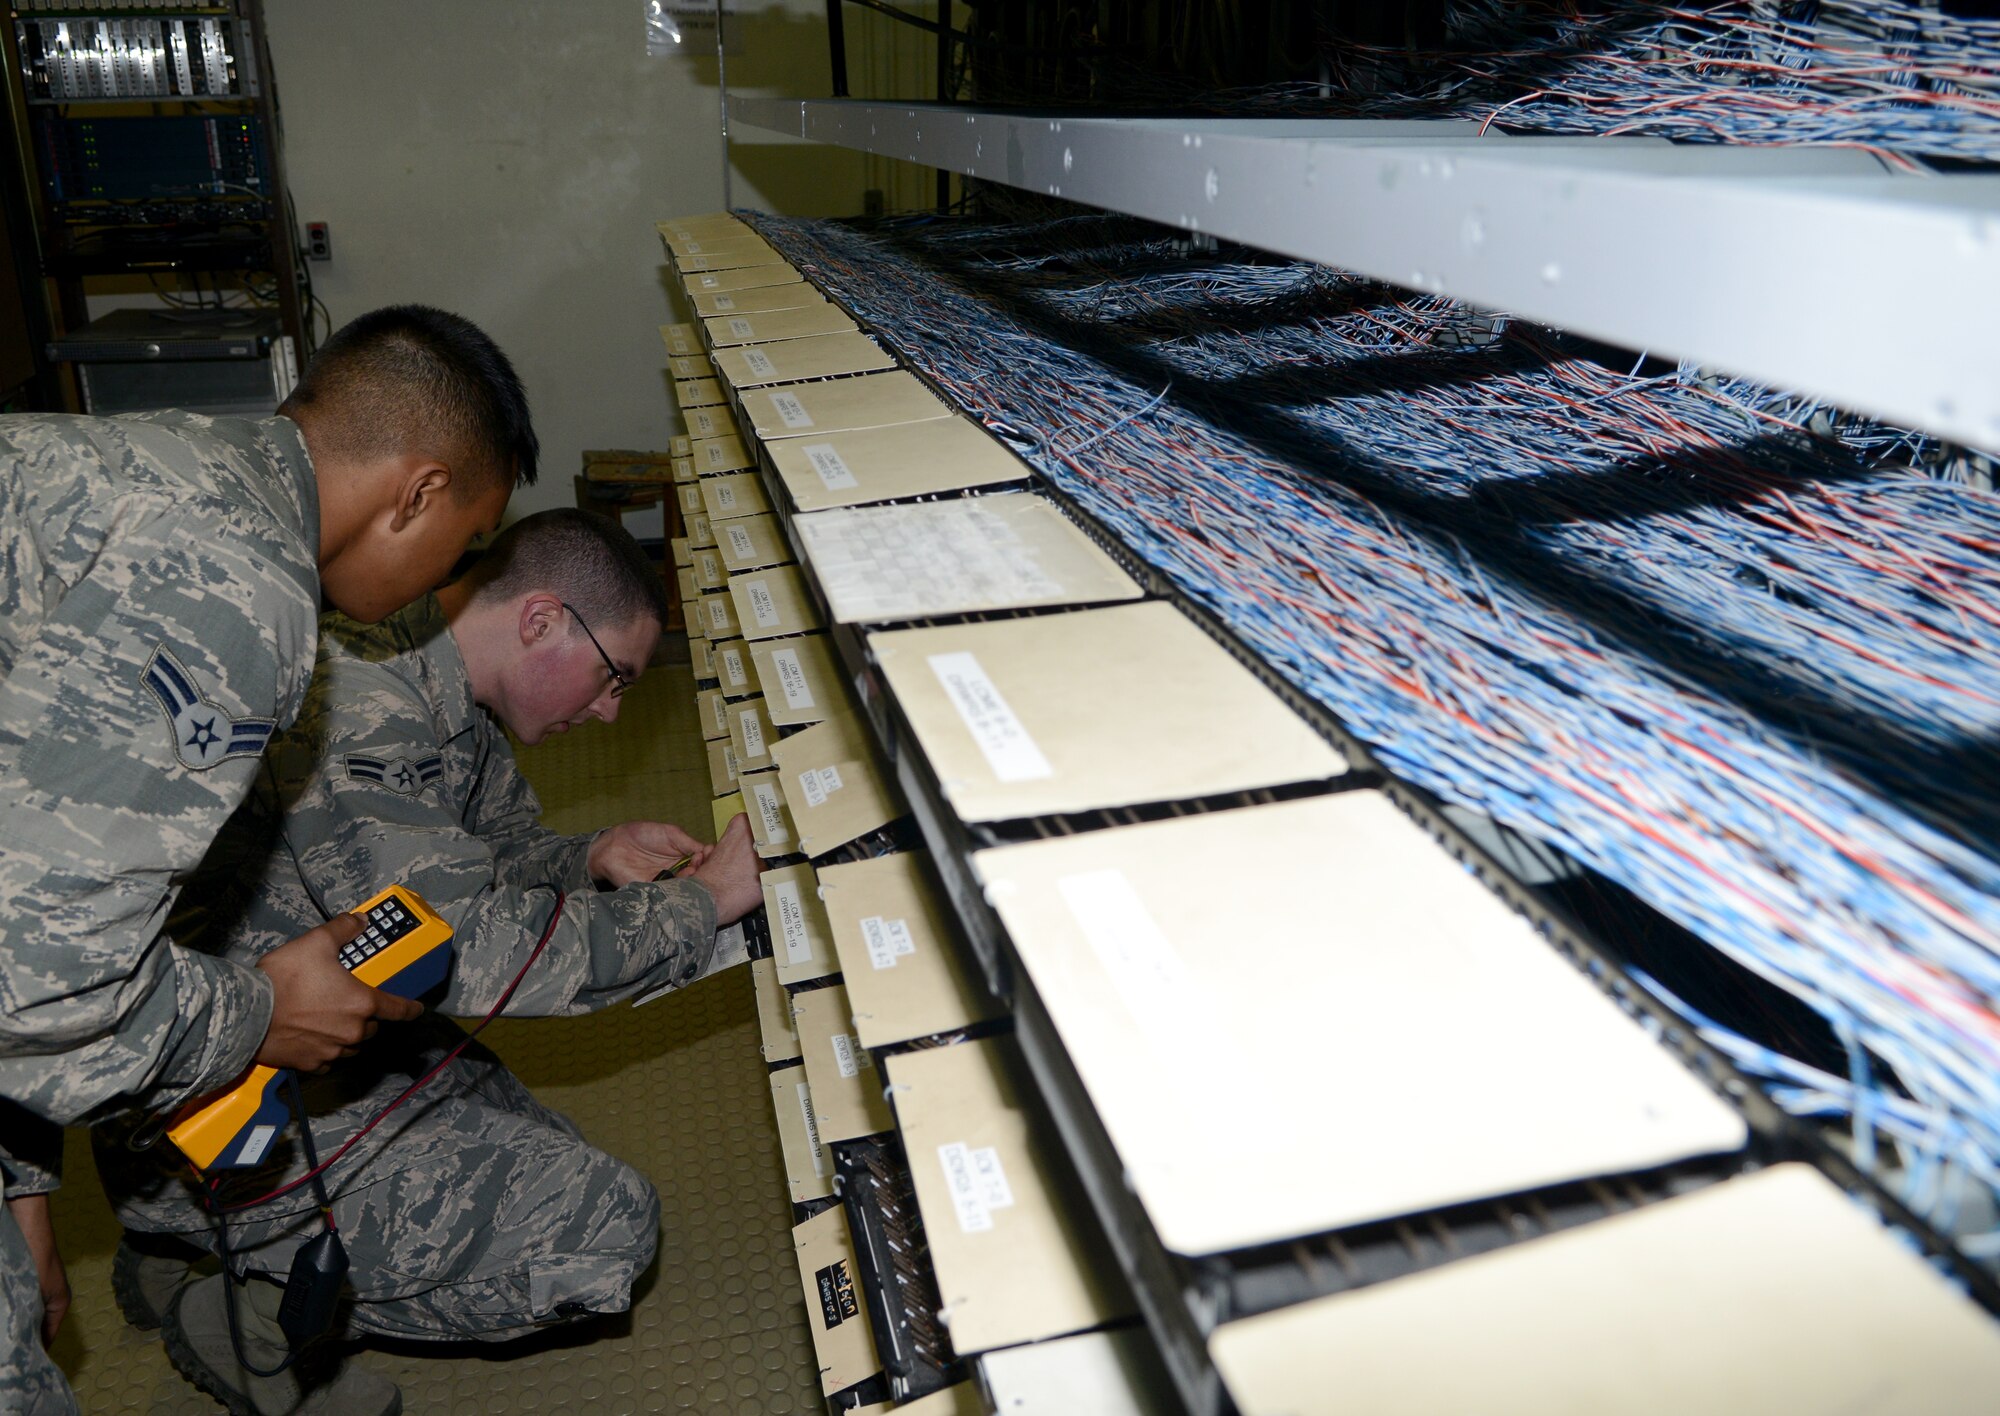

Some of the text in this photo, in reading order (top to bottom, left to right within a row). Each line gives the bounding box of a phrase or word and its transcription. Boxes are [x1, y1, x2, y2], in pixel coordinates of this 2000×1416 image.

[751, 588, 766, 618] DRWRS 12-15
[759, 591, 772, 611] LCM 11-1
[727, 656, 735, 671] DRWRS
[778, 659, 798, 697] DRWRS 16-19
[788, 663, 804, 689] LCM 11-1
[743, 718, 754, 747] DRWRS 8-11
[759, 794, 775, 832] DRWRS 12-15
[767, 798, 781, 824] LCM 10-1
[780, 896, 797, 948] DRWRS 16-19
[790, 902, 803, 937] LCM 10-1
[803, 1098, 822, 1159] DRWRS 16-19
[821, 1277, 832, 1302] DRWRS
